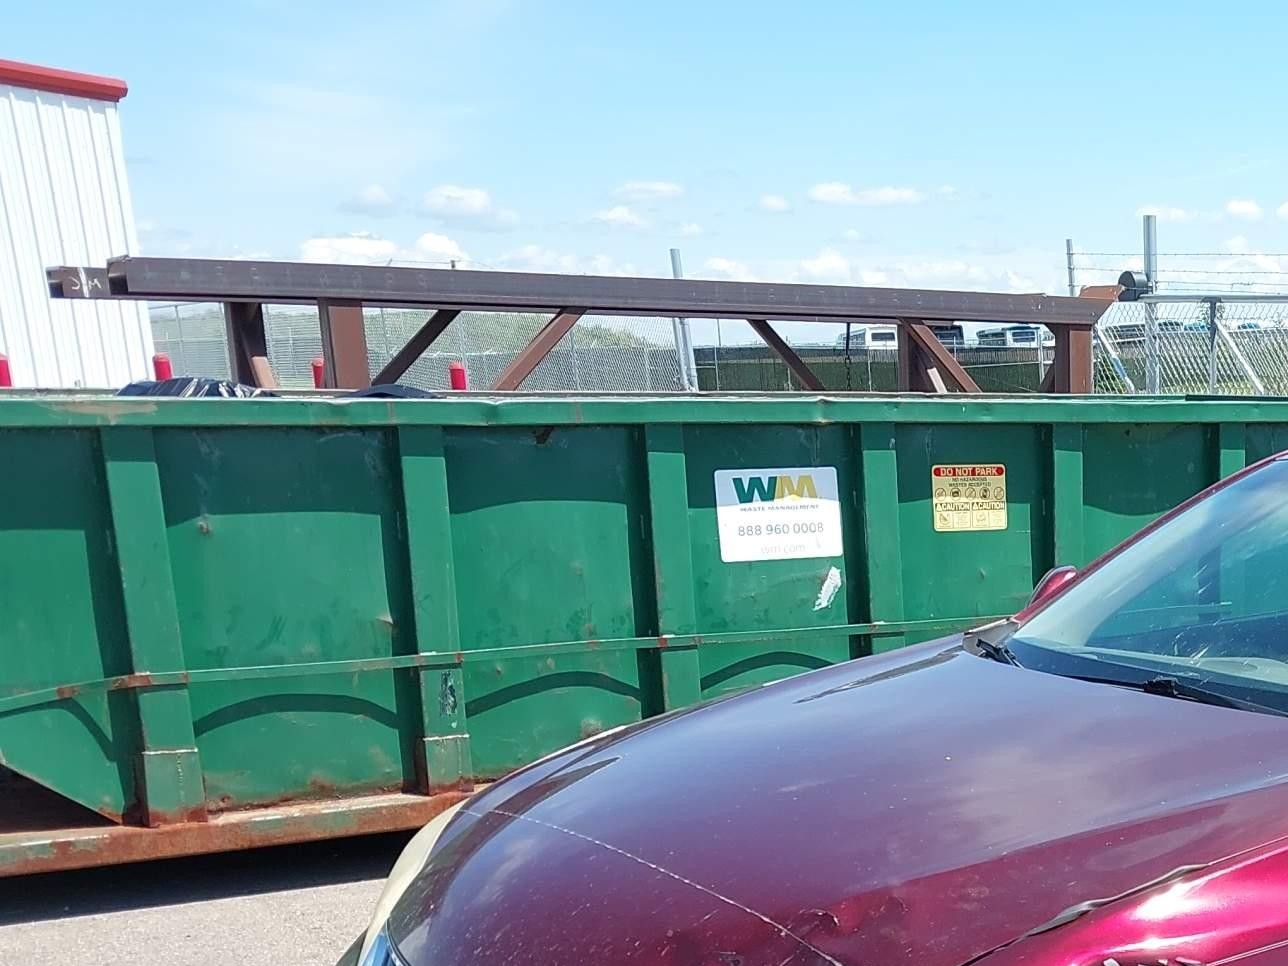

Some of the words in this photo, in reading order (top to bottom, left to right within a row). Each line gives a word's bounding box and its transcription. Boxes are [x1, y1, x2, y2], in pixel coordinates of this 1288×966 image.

[940, 467, 953, 476] DO
[956, 467, 974, 476] NOT
[975, 466, 998, 476] PARK
[732, 475, 817, 504] WM
[942, 503, 970, 511] CAUTION
[978, 502, 1005, 510] CAUTION
[738, 524, 763, 537] 888
[766, 523, 790, 535] 960
[793, 522, 824, 534] 0008
